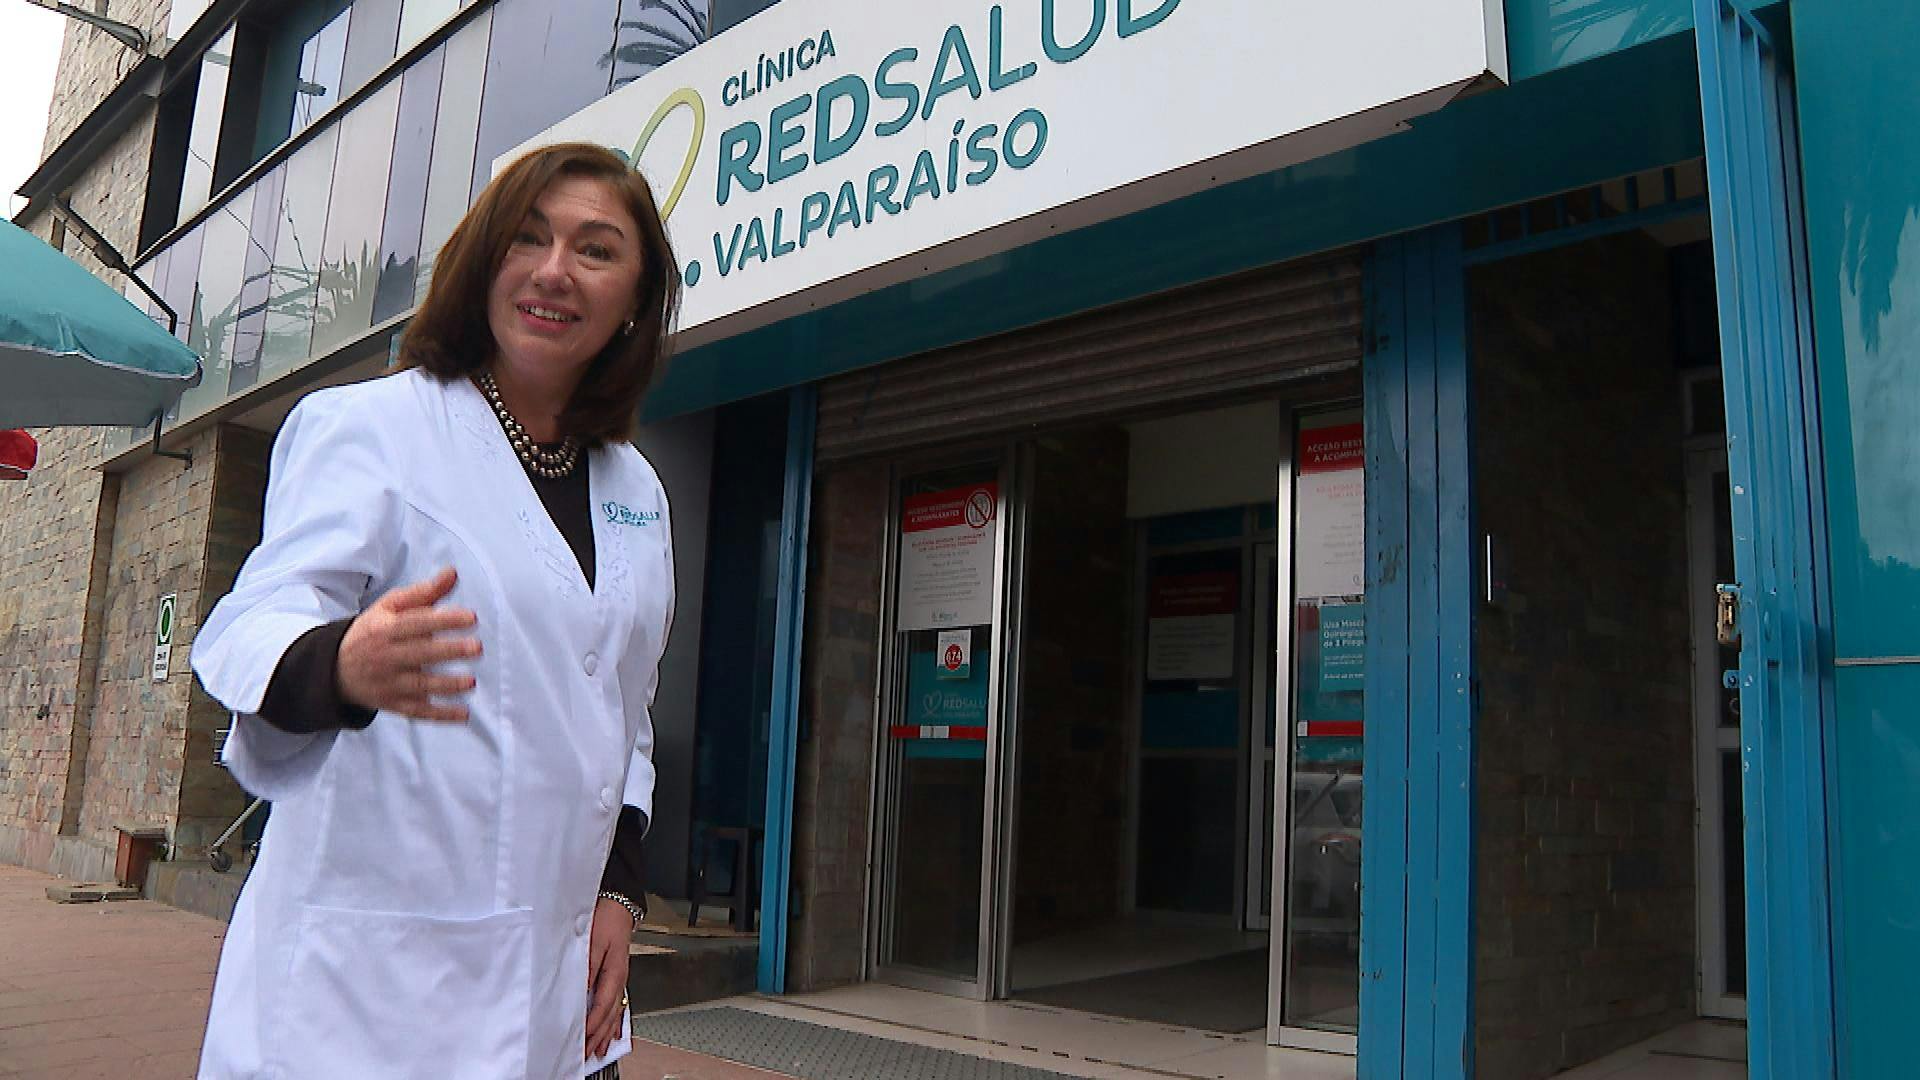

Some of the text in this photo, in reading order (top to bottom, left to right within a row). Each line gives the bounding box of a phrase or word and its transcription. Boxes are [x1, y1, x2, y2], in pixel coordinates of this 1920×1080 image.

[721, 29, 836, 107] CLÍNICA
[712, 109, 1049, 278] VALPARAÍSO
[1313, 453, 1321, 463] A
